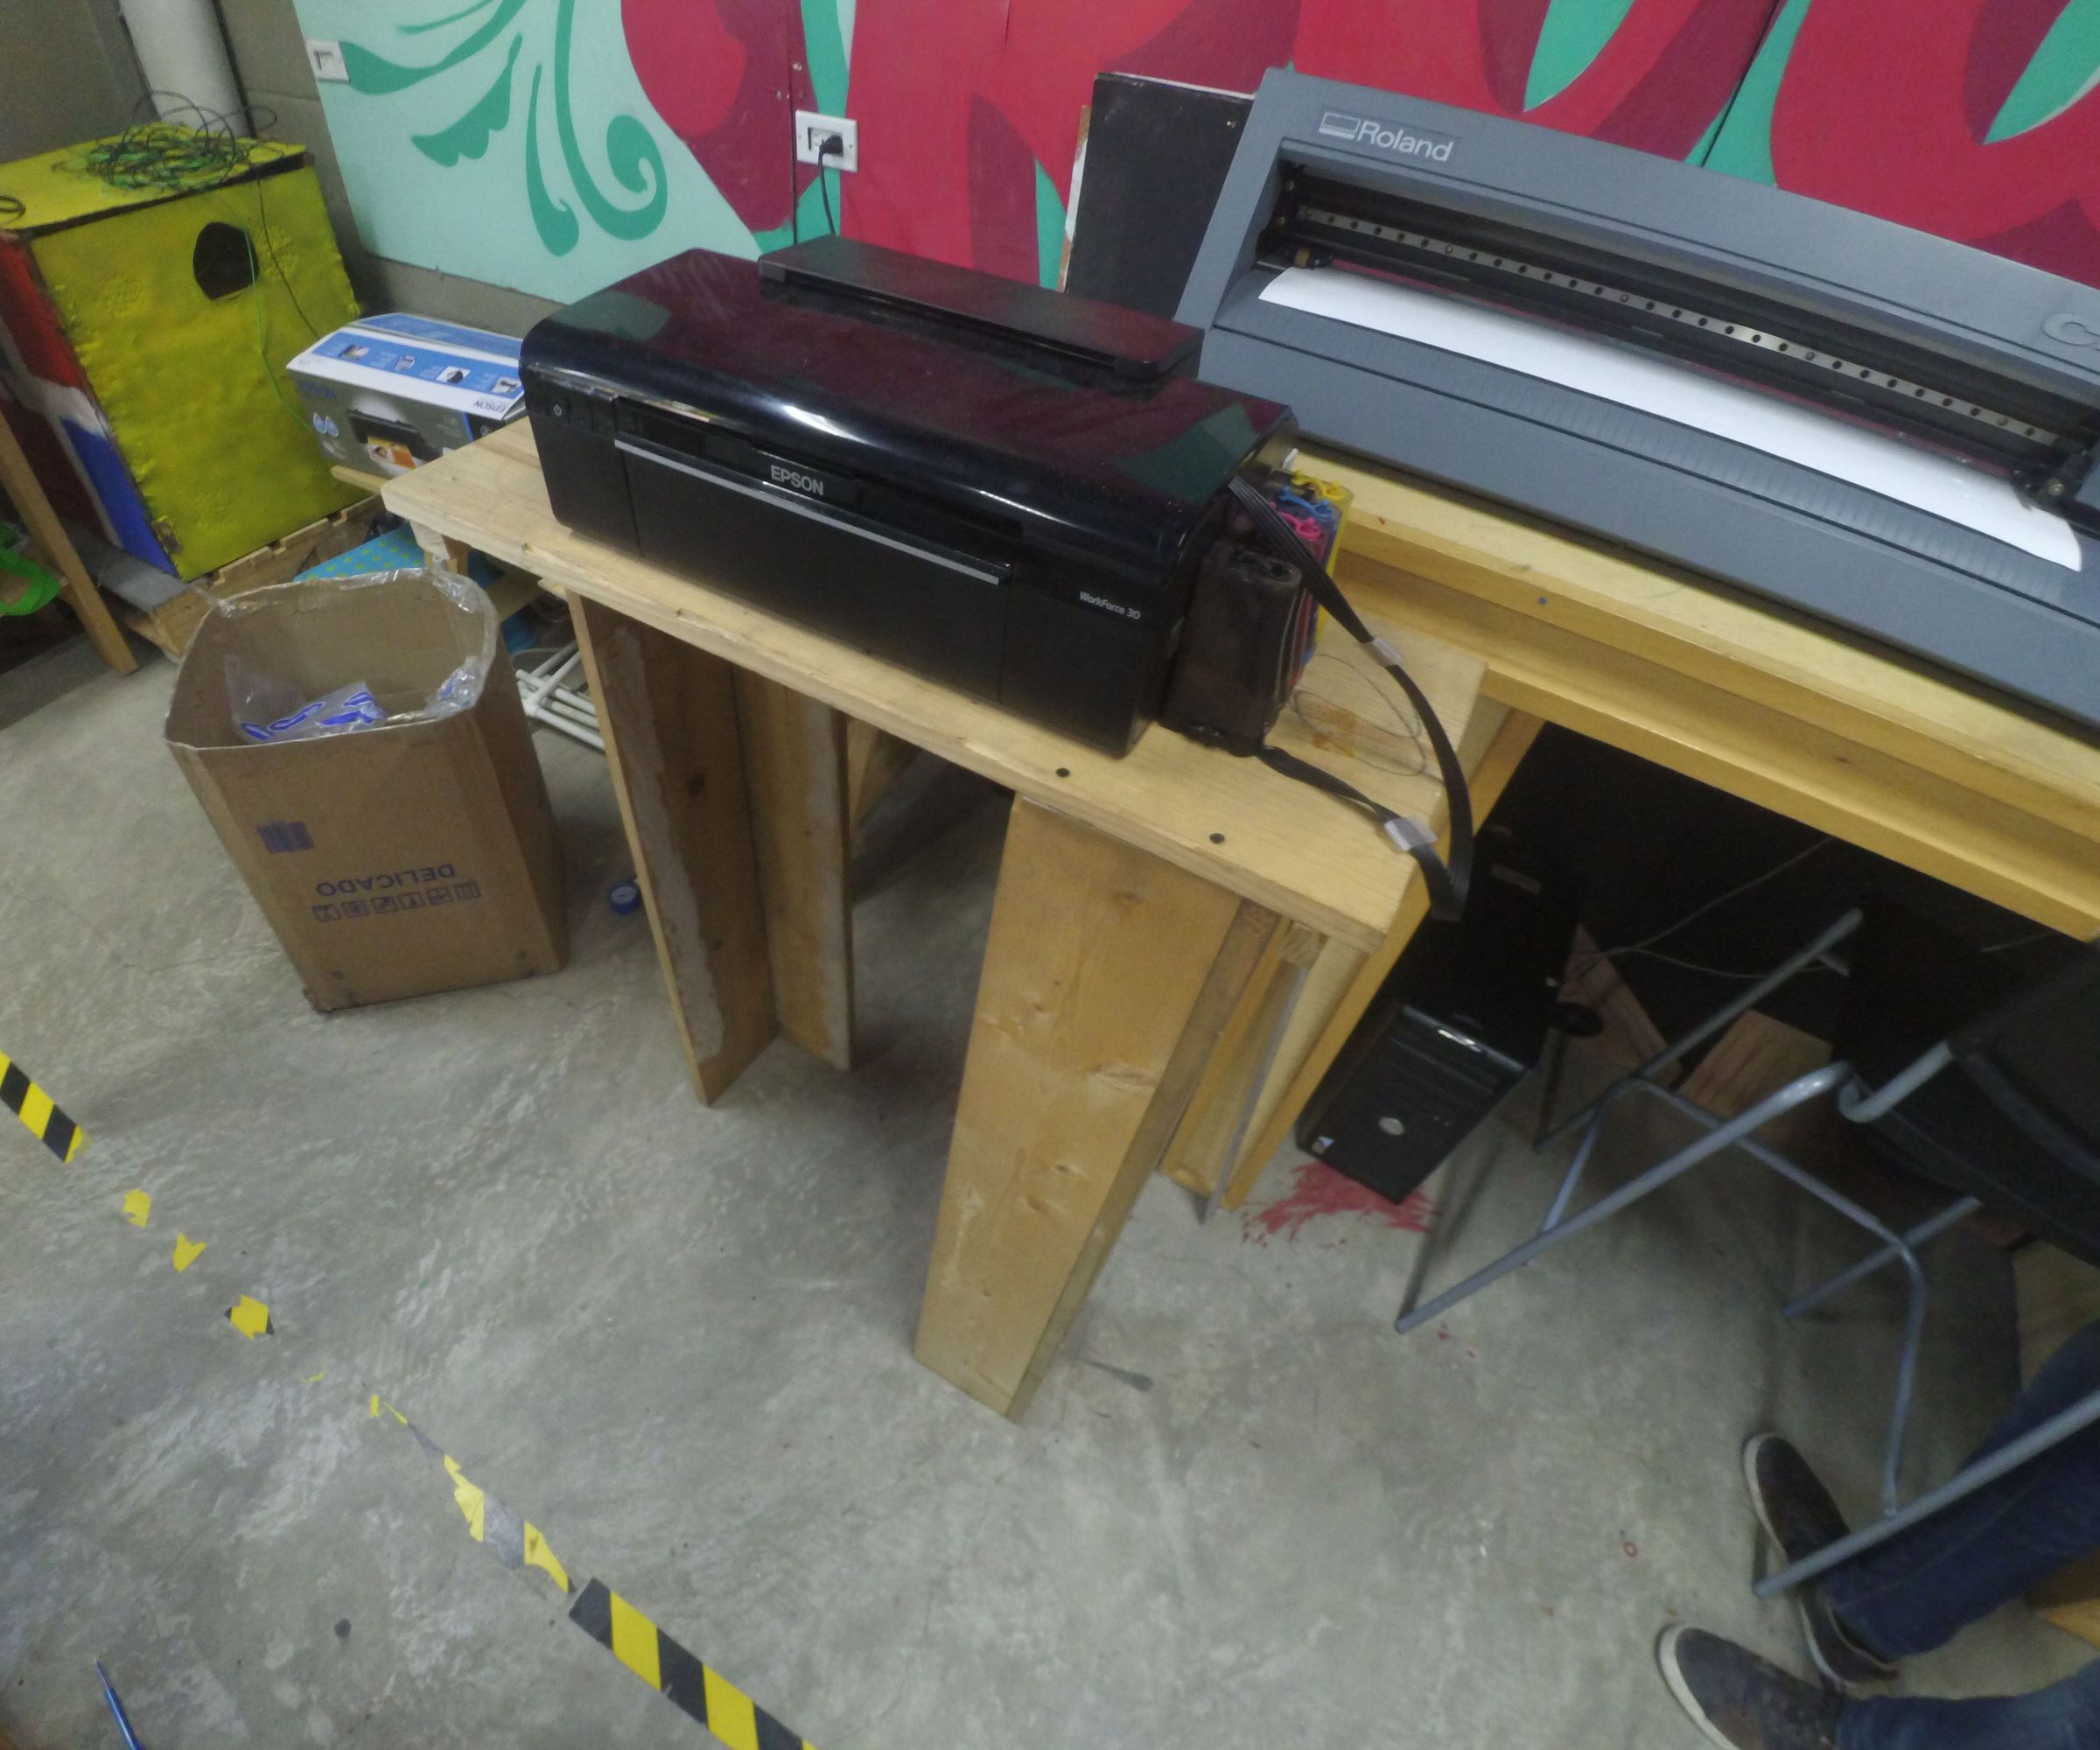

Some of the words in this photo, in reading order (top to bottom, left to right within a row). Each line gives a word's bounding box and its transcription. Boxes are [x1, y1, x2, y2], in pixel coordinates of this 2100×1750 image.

[1357, 121, 1454, 162] Roland
[771, 465, 824, 496] EPSON
[1080, 591, 1125, 614] WorkForce
[1126, 607, 1141, 620] 30
[315, 864, 456, 897] DELICADO
